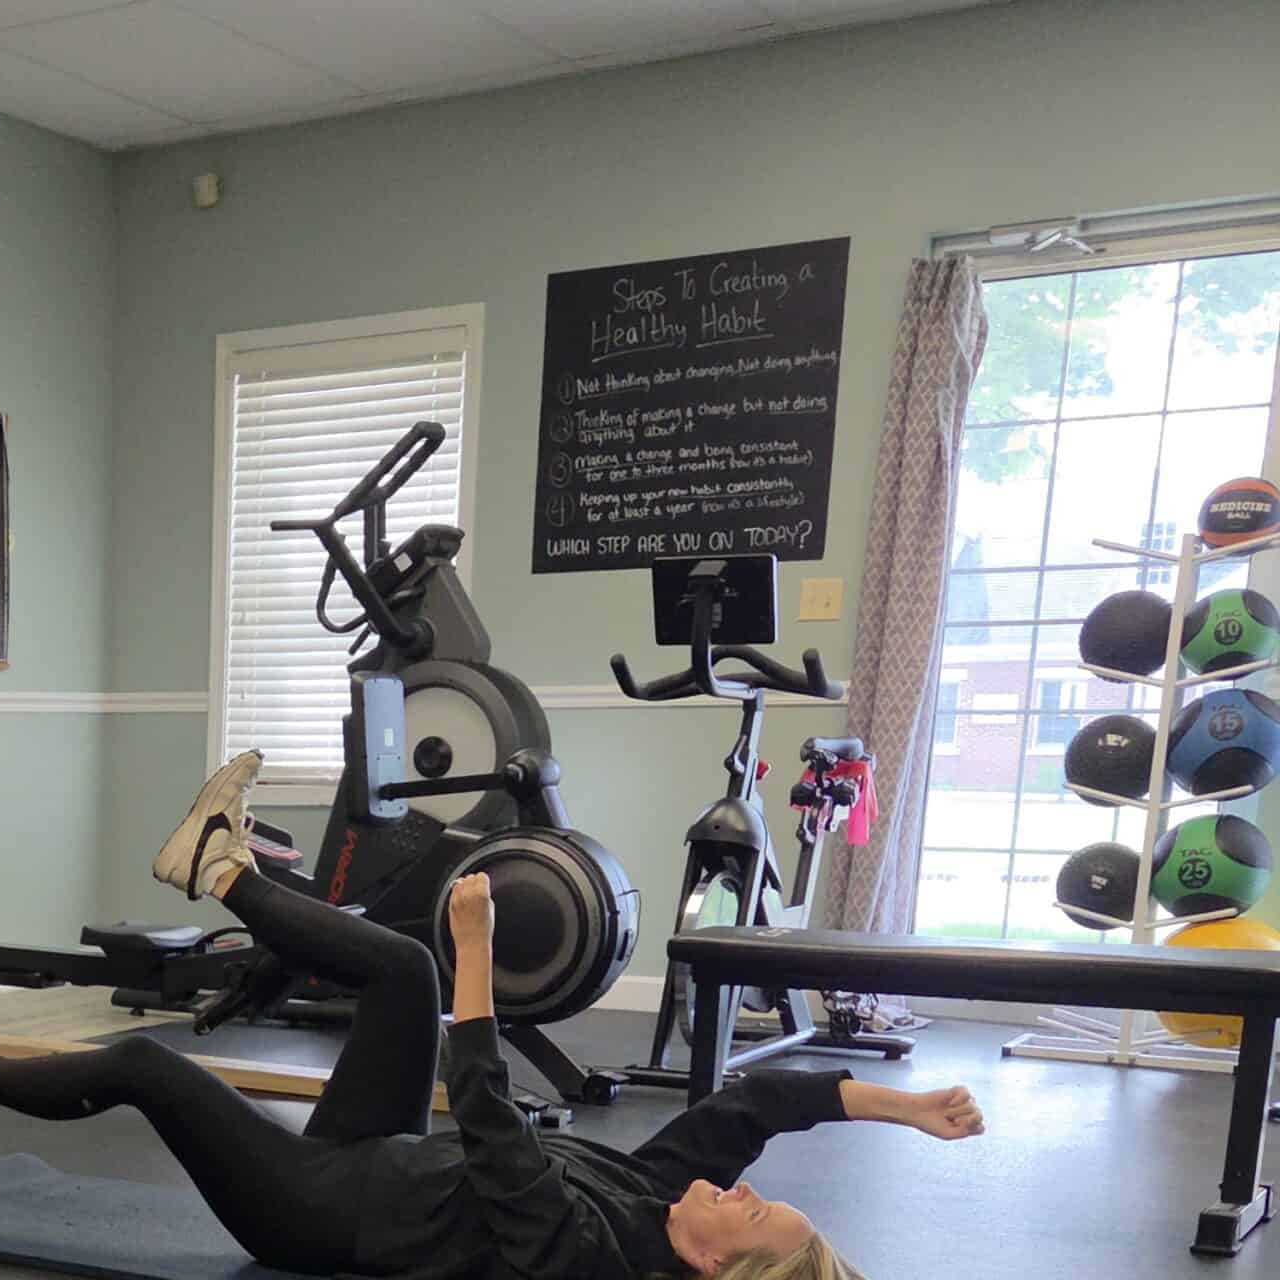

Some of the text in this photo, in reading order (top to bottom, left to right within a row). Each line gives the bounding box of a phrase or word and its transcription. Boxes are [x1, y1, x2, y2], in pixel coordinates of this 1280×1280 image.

[613, 260, 815, 313] Steps To Creating a
[591, 299, 767, 354] Healthy Habit
[576, 377, 600, 397] Not
[606, 371, 650, 392] thinking
[653, 367, 681, 384] about
[738, 356, 760, 373] Not
[763, 356, 792, 375] doing
[794, 347, 837, 367] anything
[575, 408, 623, 428] Thinking
[626, 407, 640, 426] of
[641, 407, 682, 424] making
[697, 402, 736, 419] change
[743, 396, 764, 413] but
[767, 396, 789, 411] not
[792, 395, 828, 412] doing
[579, 420, 696, 447] anything about it
[636, 448, 673, 463] change
[678, 446, 700, 459] and
[704, 443, 734, 459] being
[586, 470, 604, 483] for
[609, 469, 628, 483] one
[645, 463, 674, 477] three
[678, 459, 726, 474] months
[580, 491, 620, 508] Keeping
[623, 492, 638, 505] up
[641, 490, 666, 505] your
[667, 488, 689, 498] new
[690, 483, 722, 496] habit
[1209, 501, 1272, 513] MEDICINE
[587, 507, 603, 522] for
[608, 507, 620, 521] at
[624, 506, 651, 519] least
[666, 503, 695, 519] year
[1225, 512, 1251, 520] BALL
[547, 519, 813, 557] WHICH STEP ARE YOU ON TODAY?
[1217, 620, 1239, 637] 10
[1217, 714, 1238, 731] 15
[1181, 862, 1209, 881] 25
